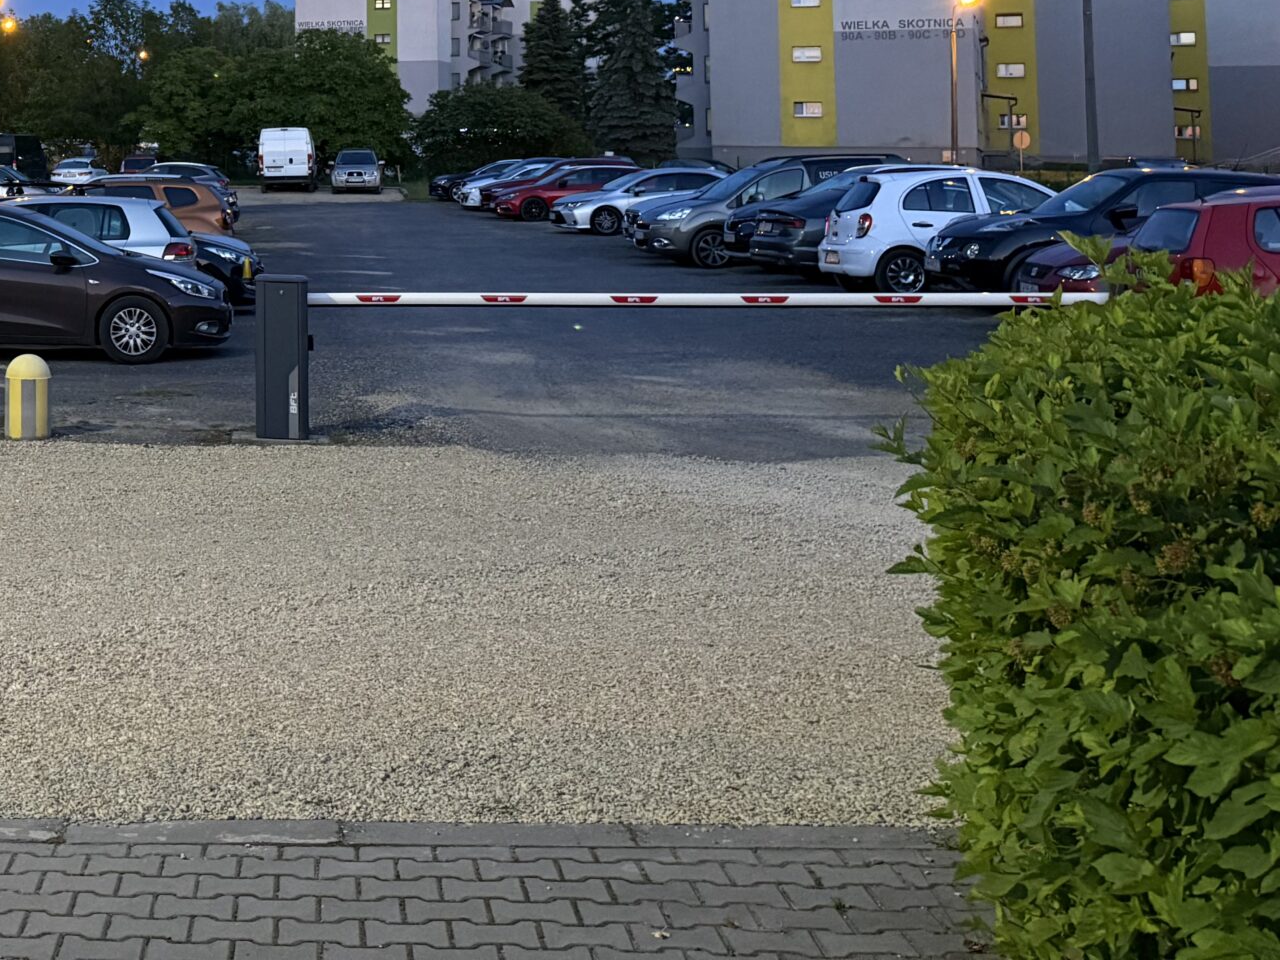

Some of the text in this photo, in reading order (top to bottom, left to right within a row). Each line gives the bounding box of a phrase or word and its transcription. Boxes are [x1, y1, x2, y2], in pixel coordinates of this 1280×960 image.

[326, 19, 364, 28] SKOTNICA
[841, 20, 890, 30] WIELKA
[841, 31, 864, 41] 90A
[874, 31, 896, 40] 90B
[908, 30, 930, 39] 90C
